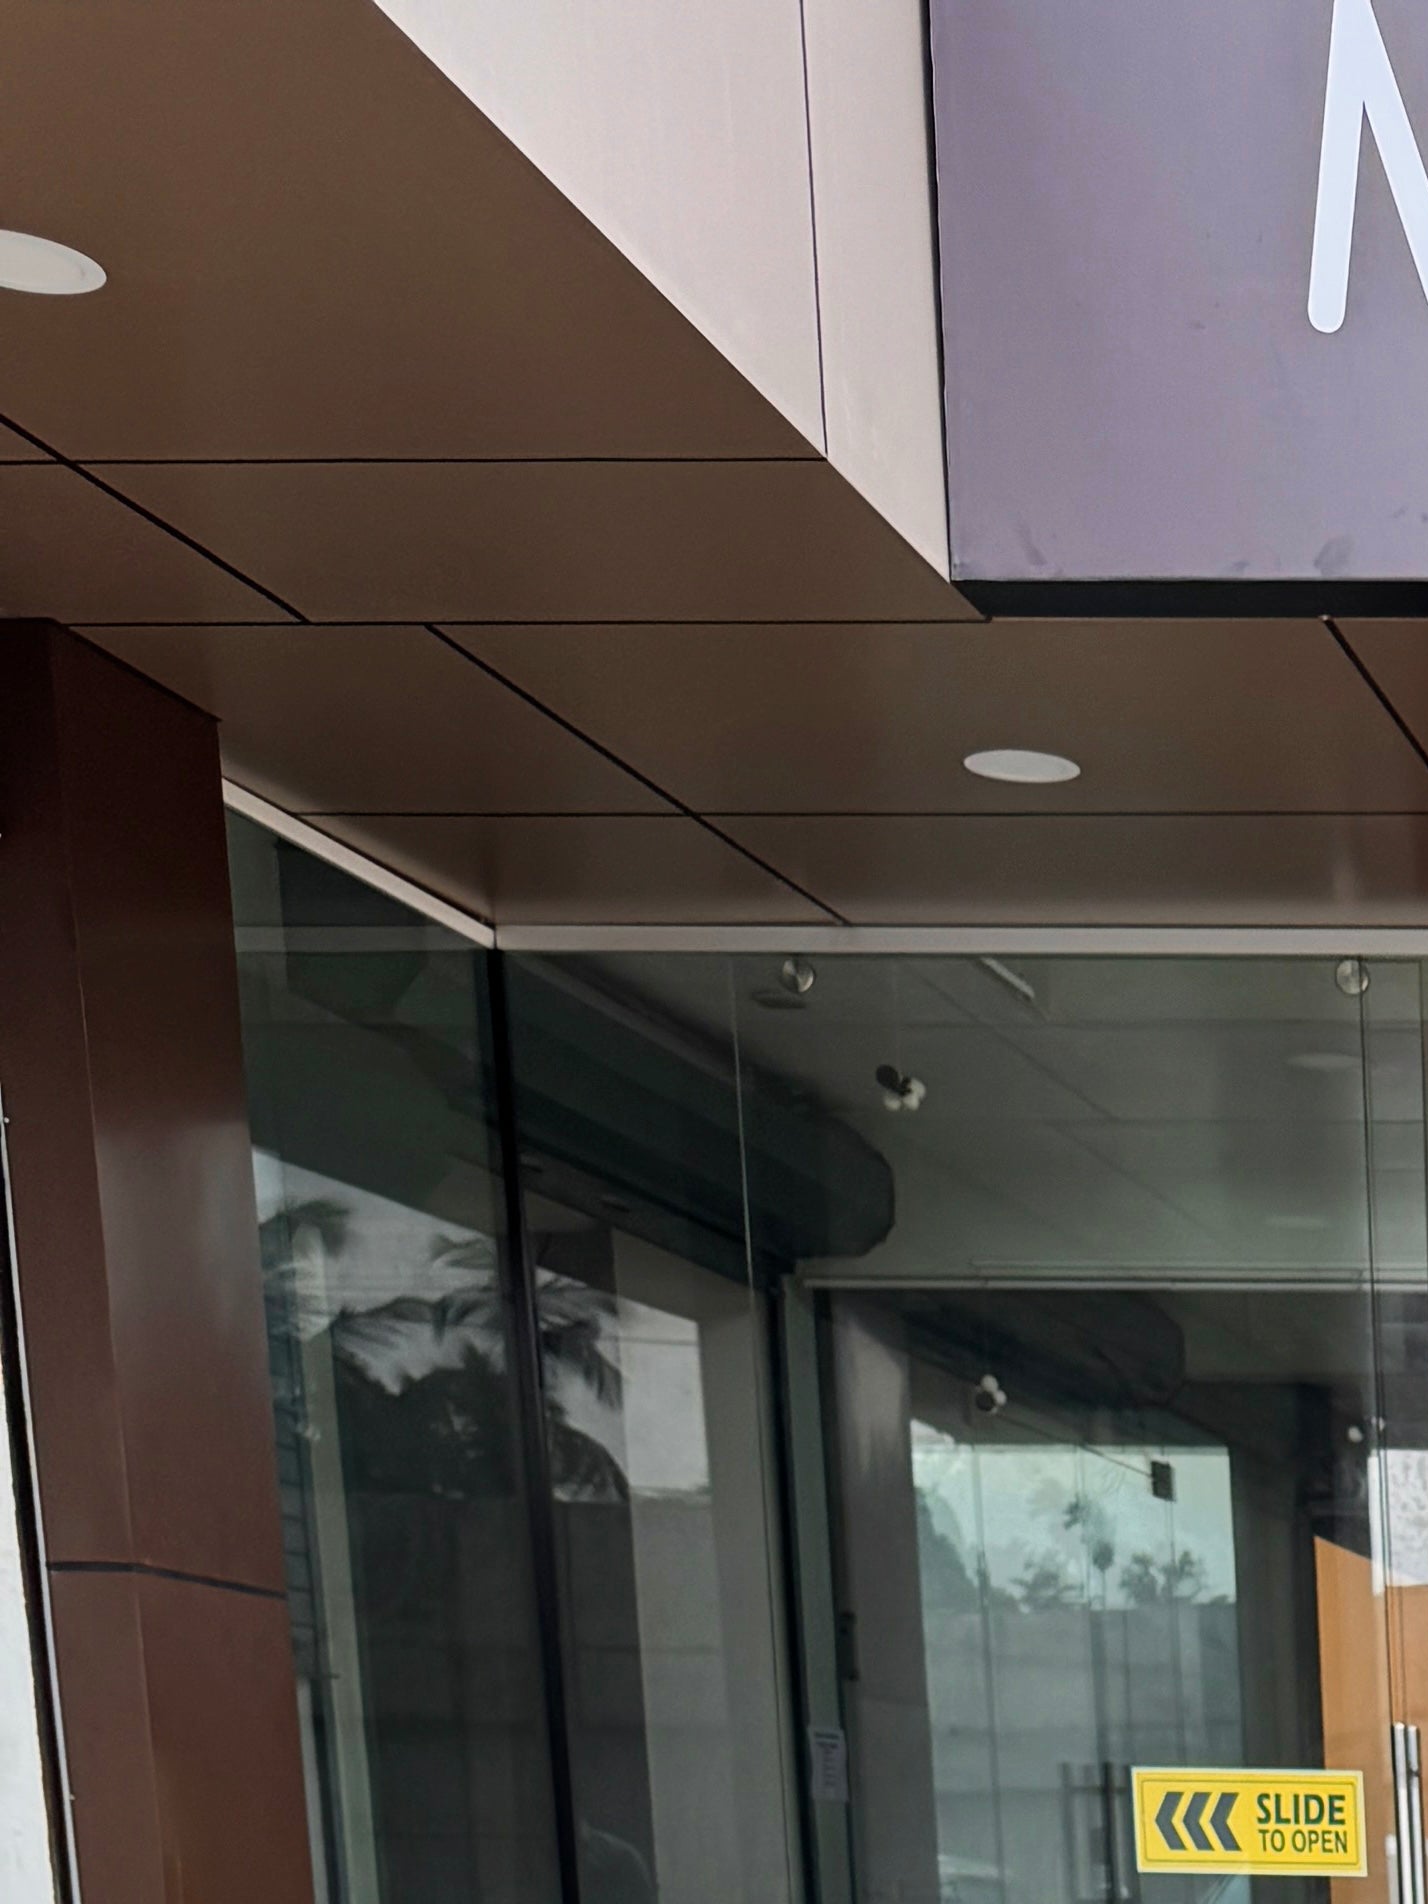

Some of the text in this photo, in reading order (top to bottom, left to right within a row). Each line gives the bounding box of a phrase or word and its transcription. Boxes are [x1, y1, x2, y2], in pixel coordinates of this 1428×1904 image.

[1256, 1792, 1346, 1827] SLIDE
[1258, 1829, 1348, 1854] TO OPEN
